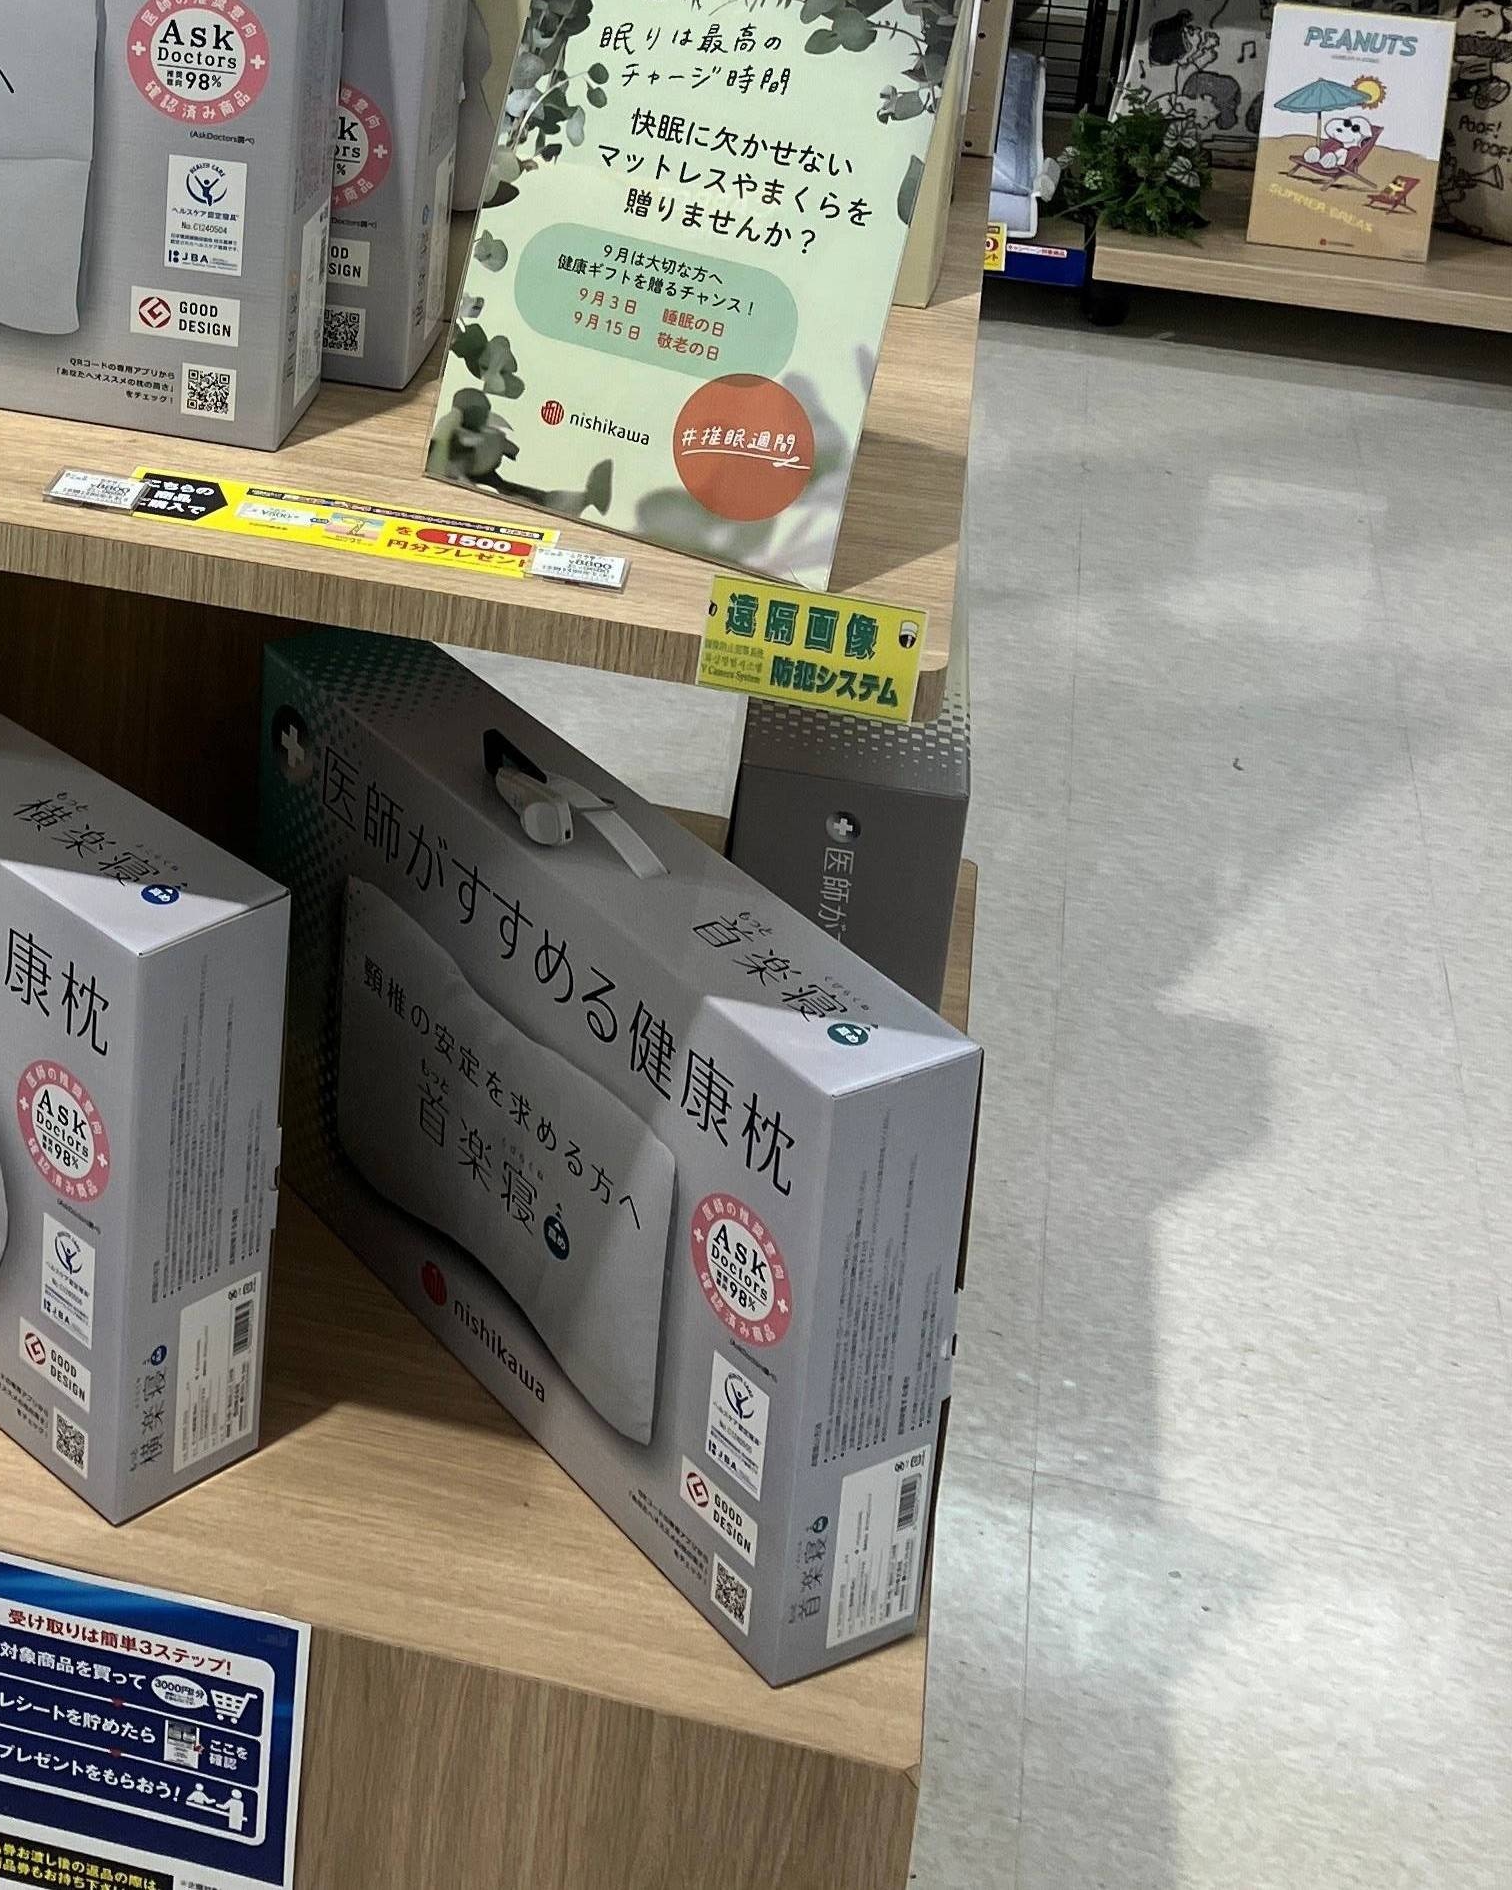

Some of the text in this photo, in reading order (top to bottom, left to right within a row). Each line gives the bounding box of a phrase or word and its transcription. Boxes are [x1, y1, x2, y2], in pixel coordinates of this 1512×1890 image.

[159, 19, 236, 52] Ask
[599, 23, 783, 56] 眠りは最高の
[1304, 26, 1419, 58] PEANUTS
[157, 45, 238, 70] Doctors
[144, 79, 252, 121] 確認済み商品
[185, 71, 222, 92] 98%
[621, 66, 792, 97] チャージ時間
[630, 107, 855, 179] 快眠に欠かせない
[597, 143, 873, 228] マットレスやまくらを
[623, 186, 817, 256] 贈りませんか?
[182, 252, 209, 264] JBA
[603, 243, 724, 287] 9月は大切な方へ
[558, 254, 756, 316] 健康ギフトを贈るチャンス!
[178, 316, 232, 338] DESIGN
[179, 300, 218, 319] GOOD
[578, 286, 726, 338] 9月3日 睡眠の日
[573, 311, 722, 362] 9月15日 敬老の日
[70, 358, 175, 379] QRコードの専用アプリから
[569, 412, 650, 446] nishikawa
[445, 532, 513, 553] 1500
[725, 592, 878, 659] 遠隔画像
[769, 655, 899, 708] 防犯システム
[320, 745, 795, 1198] 医師がすすめる健康枕
[38, 1088, 87, 1141] Ask
[362, 955, 641, 1231] 頸椎の安定を求める方へ
[35, 1109, 89, 1158] Doctors
[54, 1143, 80, 1171] 98%
[418, 1081, 538, 1236] 首楽寝
[711, 1247, 768, 1302] Doctors
[712, 1224, 767, 1283] Ask
[728, 1281, 757, 1313] 98%
[50, 1349, 77, 1378] GOOD
[453, 1299, 546, 1403] nishikawa
[50, 1365, 86, 1402] DESIGN
[713, 1509, 753, 1554] DESIGN
[714, 1493, 743, 1527] GOOD
[6, 1608, 233, 1678] 受け取りは簡単3ステップ!
[209, 1739, 248, 1760] ここを
